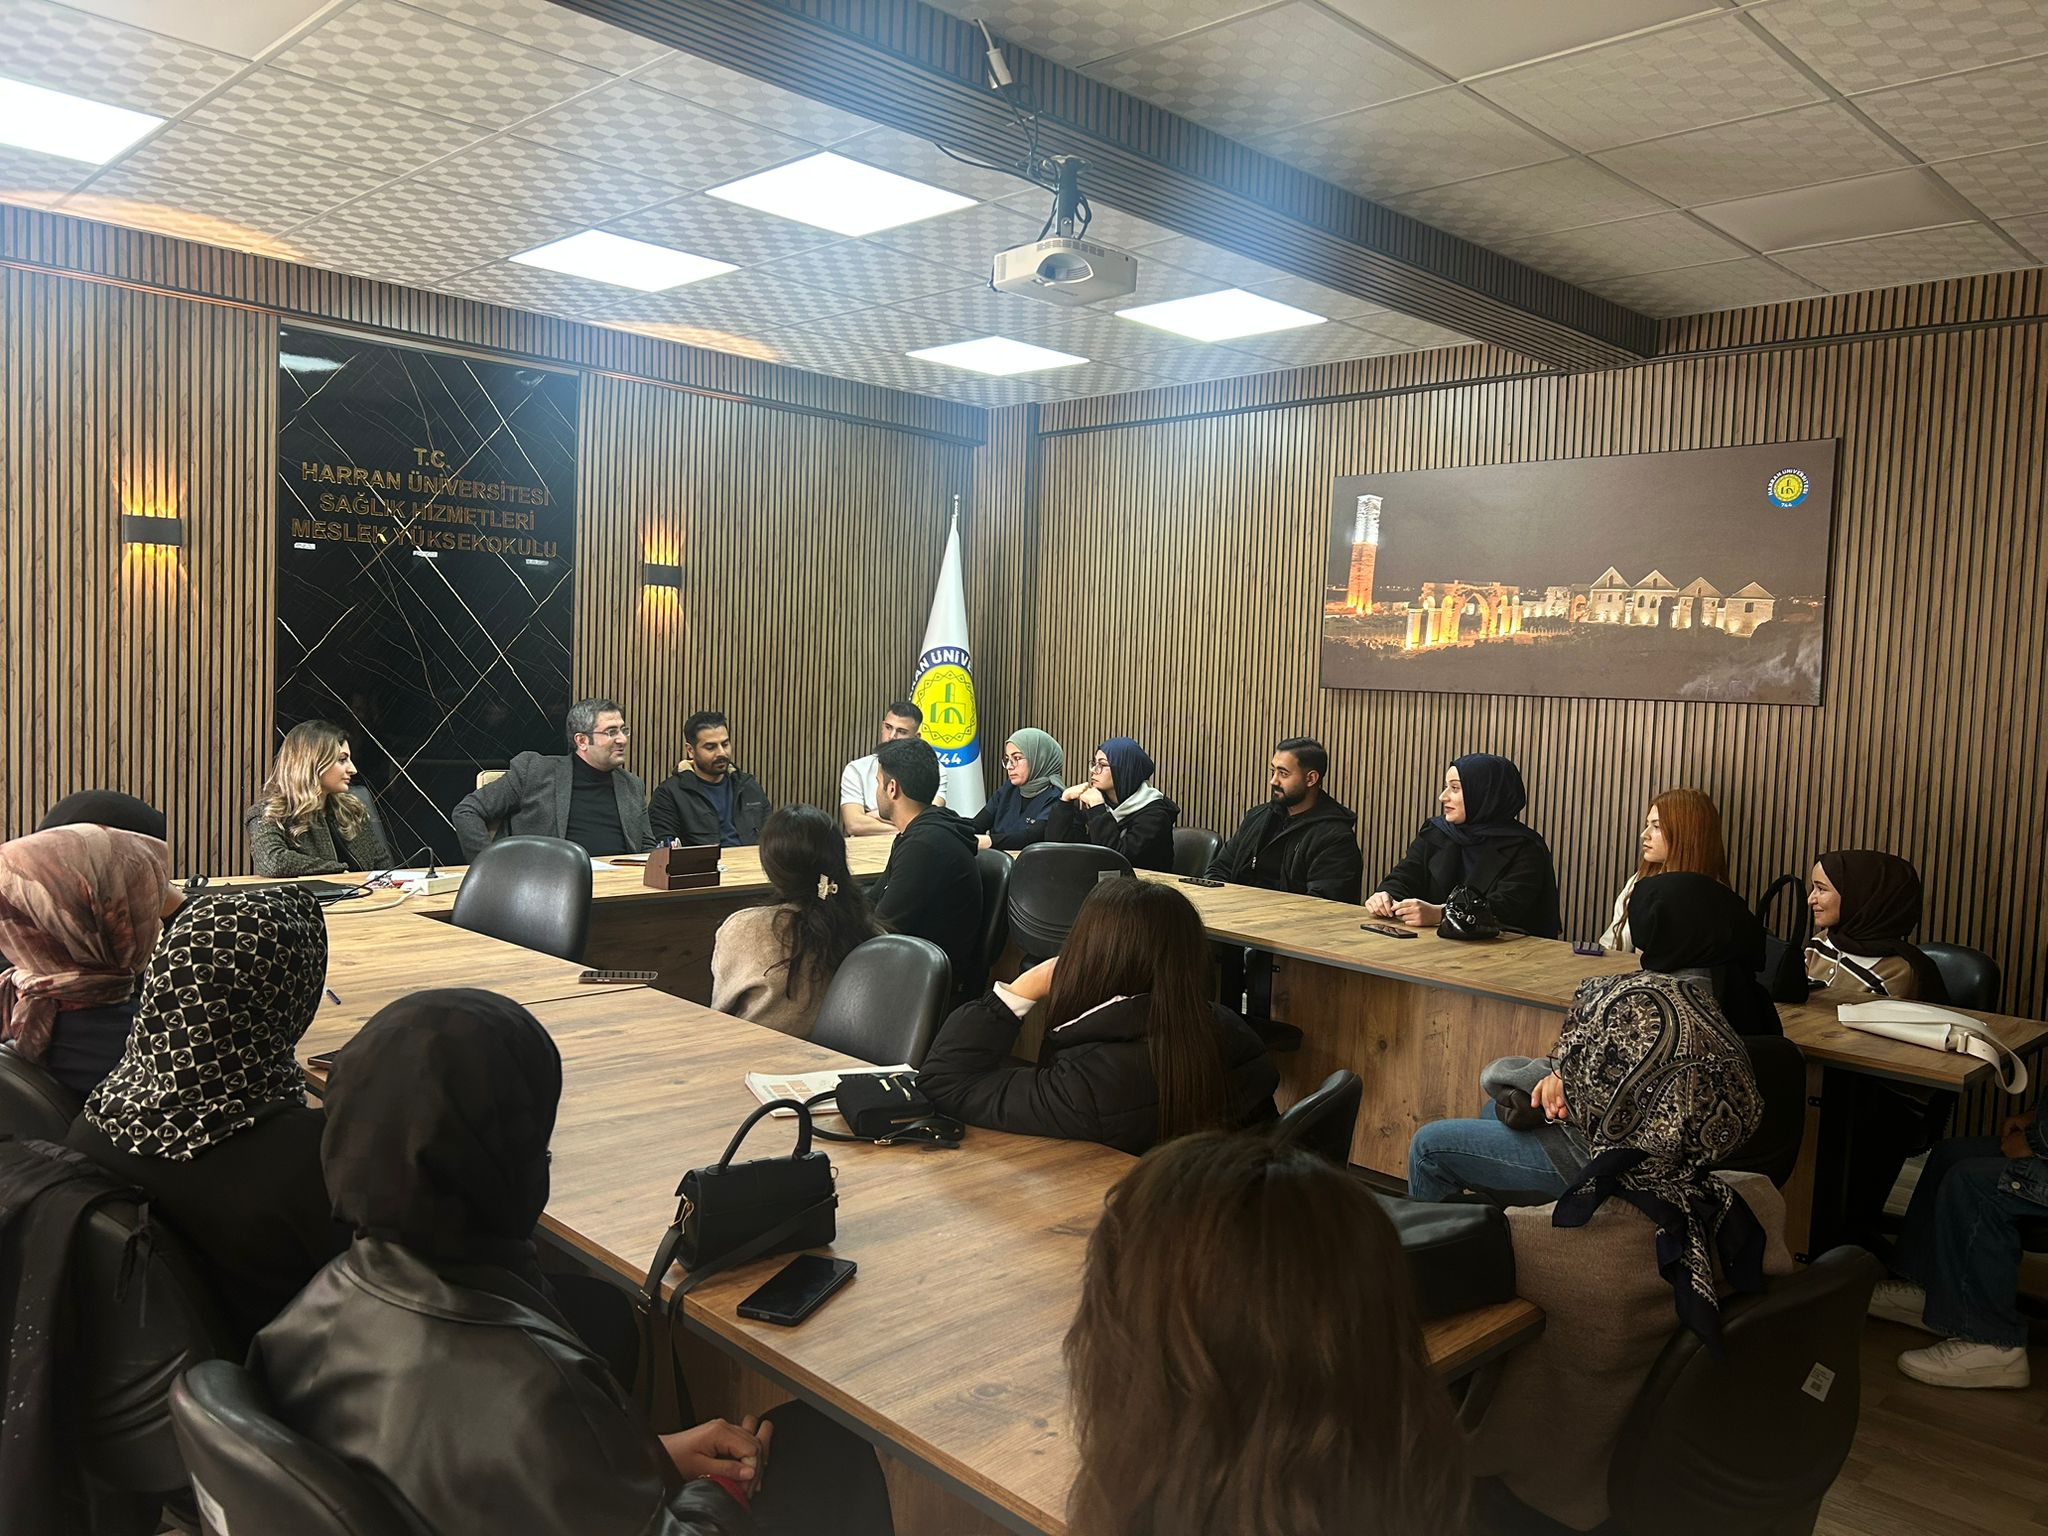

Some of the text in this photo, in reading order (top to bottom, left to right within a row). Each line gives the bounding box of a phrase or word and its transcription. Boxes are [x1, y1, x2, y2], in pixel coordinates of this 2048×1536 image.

[413, 447, 450, 469] T.C.
[302, 461, 549, 506] HARRAN ÜNİVERSİTESİ
[320, 491, 406, 519] SAĞLIK
[291, 518, 558, 558] MESLEK YÜKSEKOKULU
